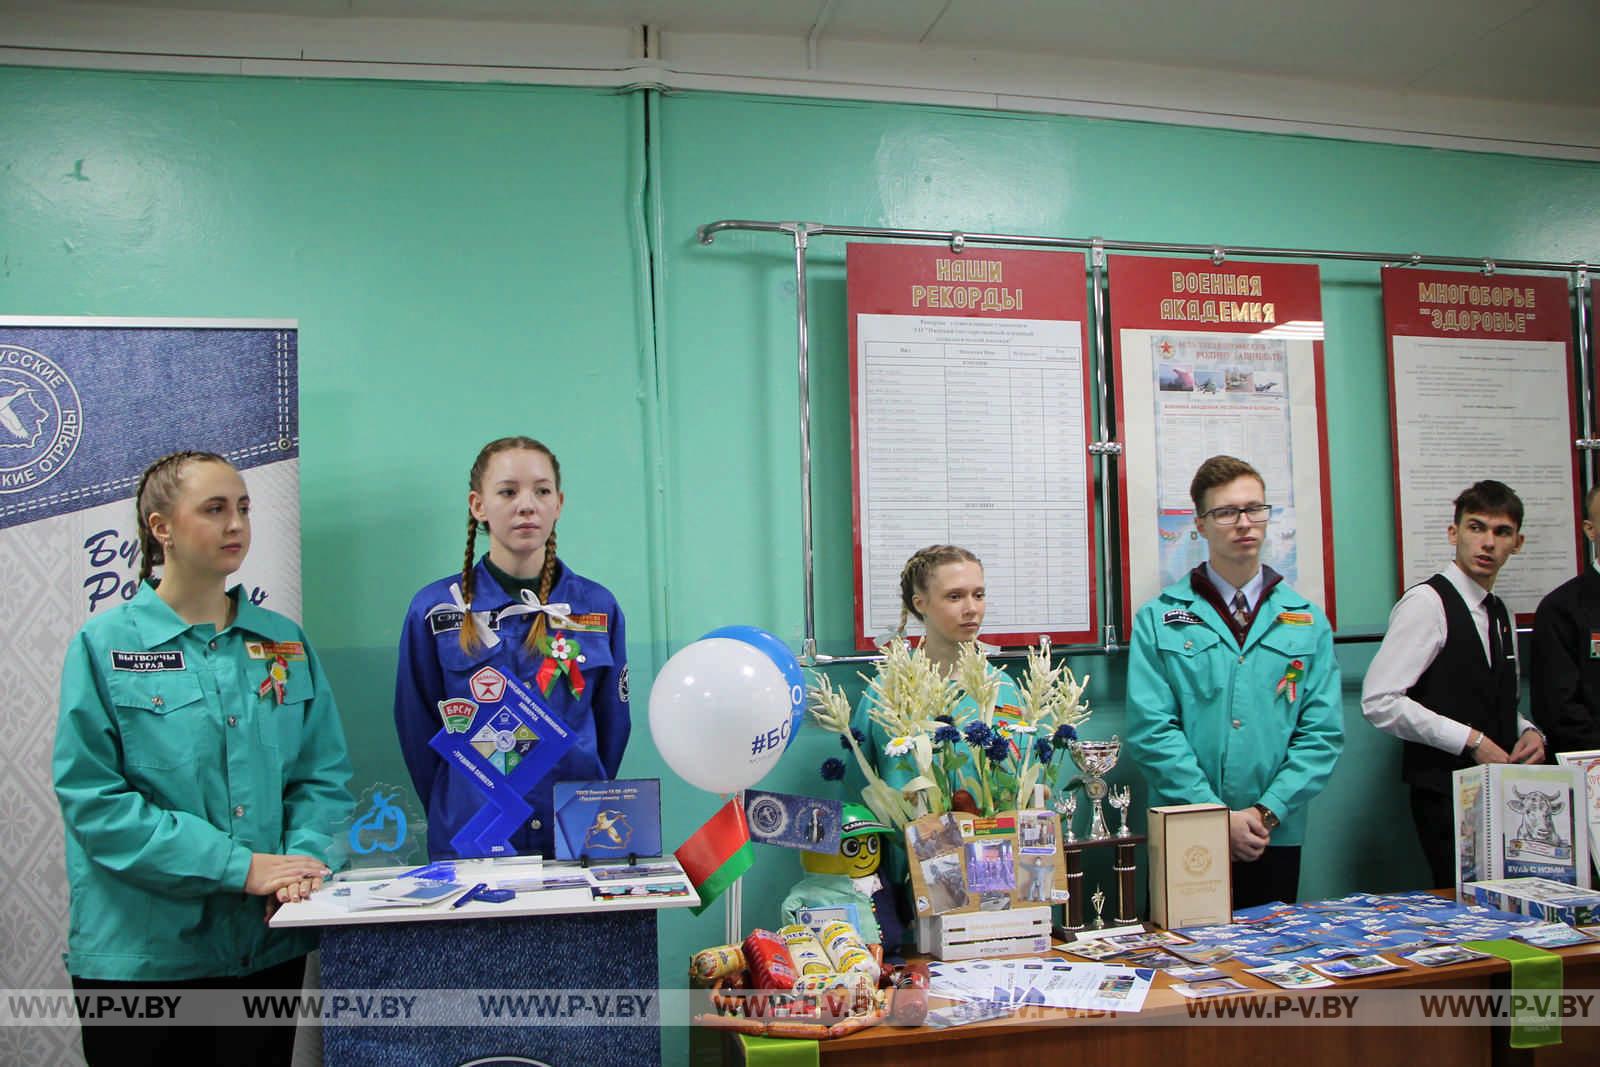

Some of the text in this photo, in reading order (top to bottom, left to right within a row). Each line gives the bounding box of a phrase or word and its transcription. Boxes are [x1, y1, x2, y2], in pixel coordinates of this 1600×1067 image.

[936, 258, 1003, 282] НАШИ
[1172, 271, 1263, 297] ВОЕННАЯ
[1418, 282, 1536, 308] МНОГОБОРЬЕ
[911, 285, 1023, 311] РЕКОРДЫ
[1160, 299, 1276, 324] АКАДЕМИЯ
[1419, 308, 1536, 333] "ЗДОРОВЬЕ"
[39, 409, 78, 472] ОТРЯДЫ
[83, 529, 142, 569] Бу
[83, 571, 140, 613] Ро
[446, 703, 472, 716] БРСМ
